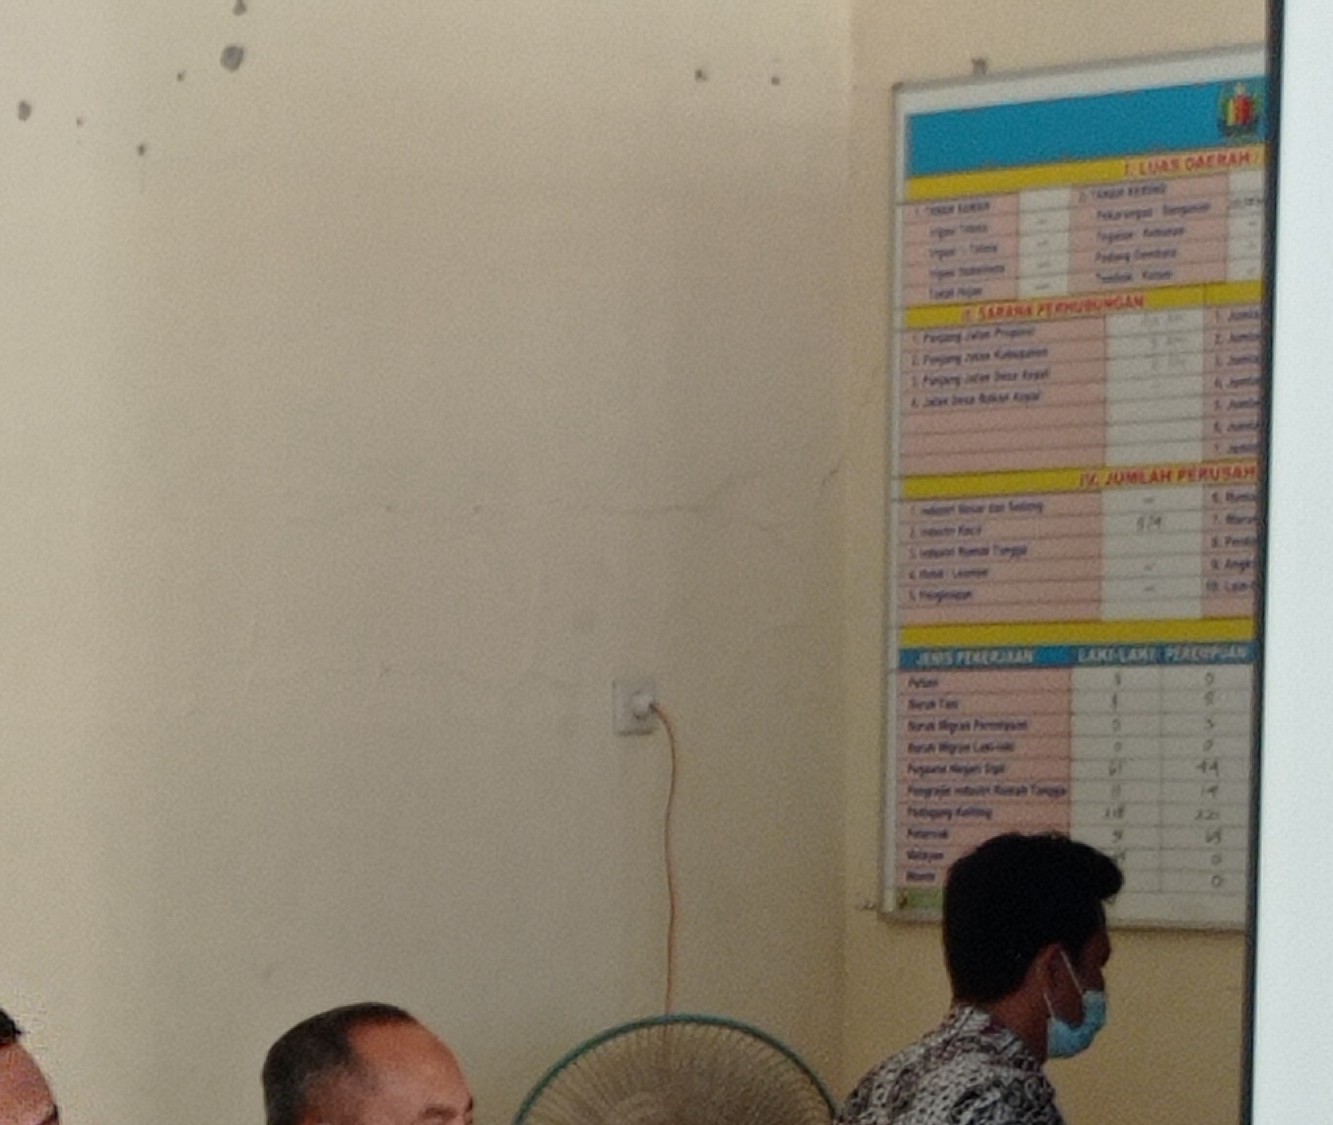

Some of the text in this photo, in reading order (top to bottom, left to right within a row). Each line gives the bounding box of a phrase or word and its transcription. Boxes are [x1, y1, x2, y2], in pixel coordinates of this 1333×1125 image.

[1140, 159, 1180, 175] LUAS
[1185, 152, 1251, 172] DAERAH
[1105, 469, 1171, 485] JUMLAH
